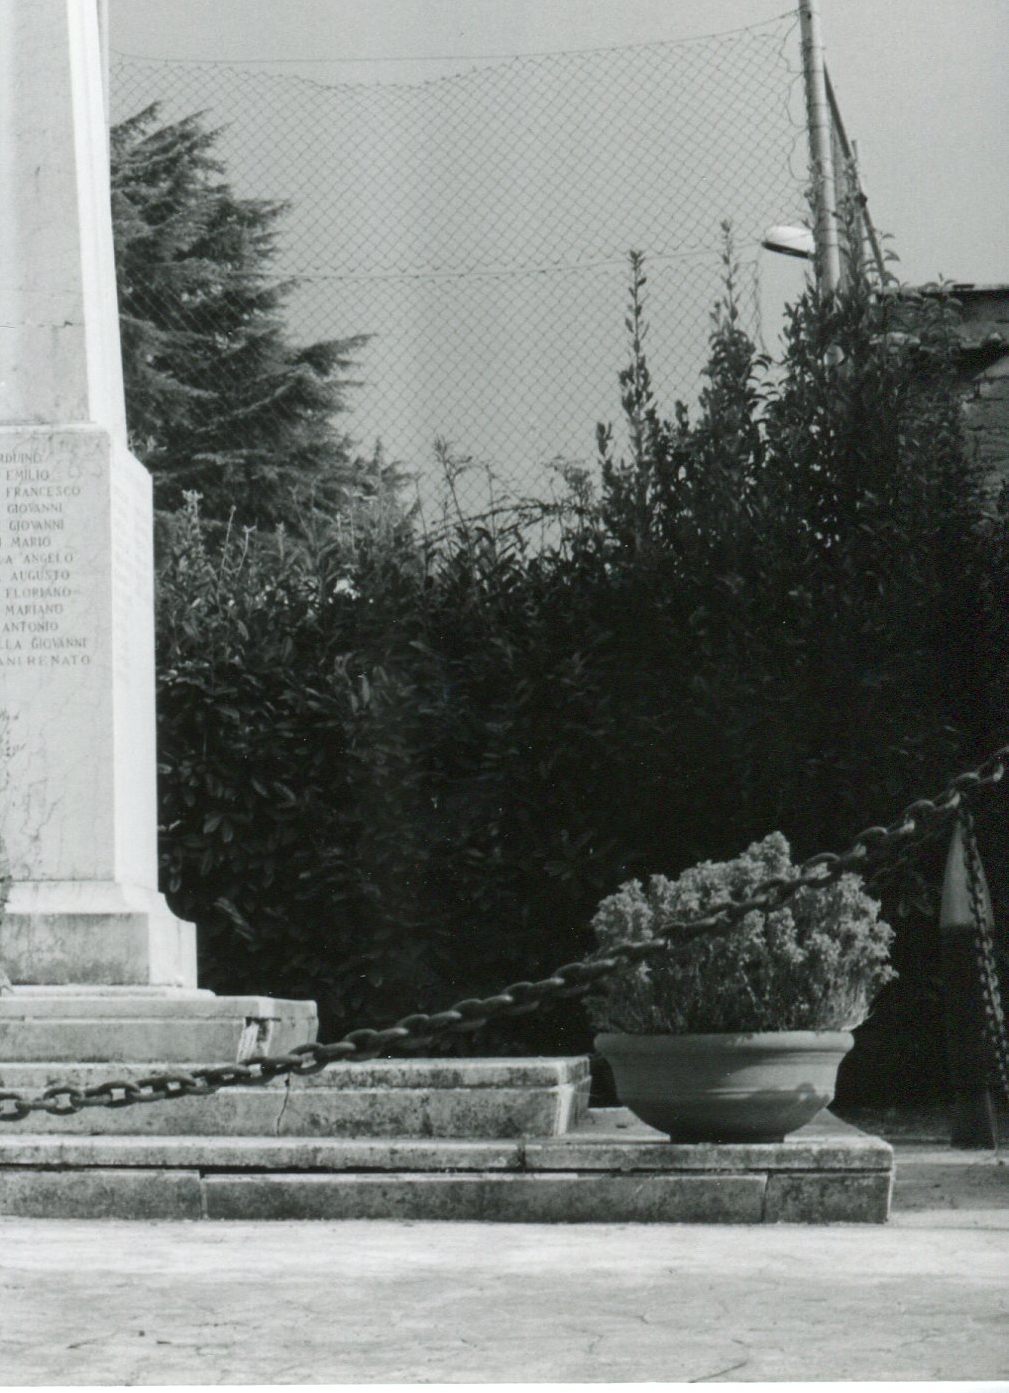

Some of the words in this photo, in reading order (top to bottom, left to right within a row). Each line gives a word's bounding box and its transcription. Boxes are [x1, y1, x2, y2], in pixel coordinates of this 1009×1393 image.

[6, 469, 50, 481] EMILIO
[6, 485, 82, 498] FRANCESCO
[7, 502, 63, 514] GIOVANNI
[9, 519, 64, 532] GIOVANNI
[11, 536, 52, 548] MARIO
[23, 552, 74, 564] ANGELO
[10, 569, 71, 582] AUGUSTO
[6, 603, 64, 616] MARIANO
[2, 620, 59, 633] ANTONIO
[31, 636, 88, 649] GIOVANNI
[27, 654, 91, 666] RENATO
